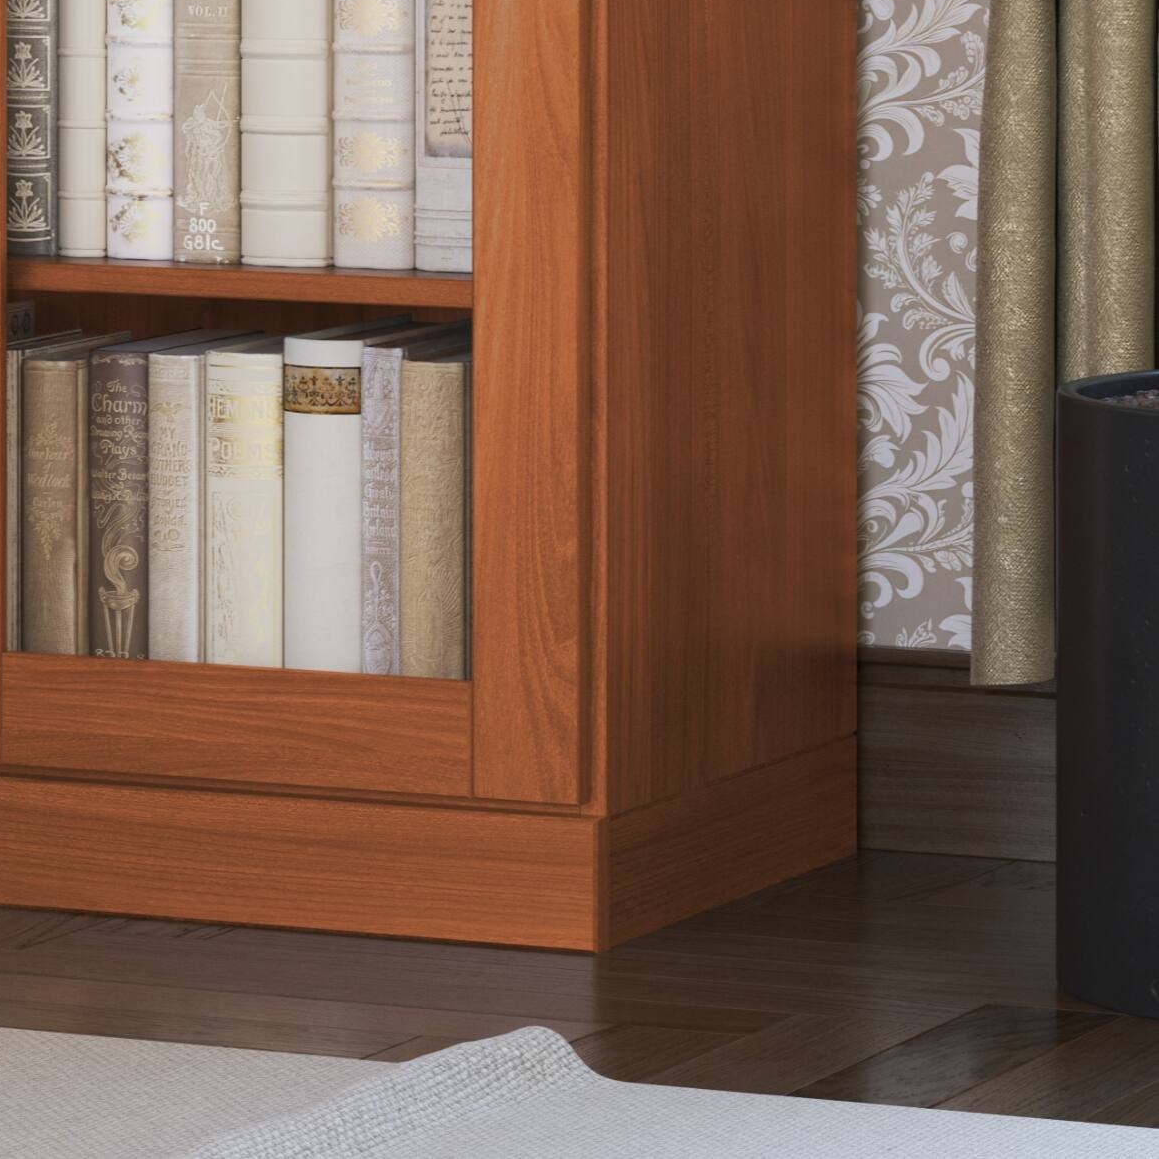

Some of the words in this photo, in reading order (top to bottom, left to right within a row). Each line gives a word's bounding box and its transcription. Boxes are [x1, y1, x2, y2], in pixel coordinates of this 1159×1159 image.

[199, 202, 210, 216] F
[189, 216, 217, 233] 800
[105, 378, 128, 393] The
[91, 392, 147, 416] Charm
[95, 415, 113, 426] and
[99, 439, 137, 460] Plays
[209, 438, 276, 461] POEMS
